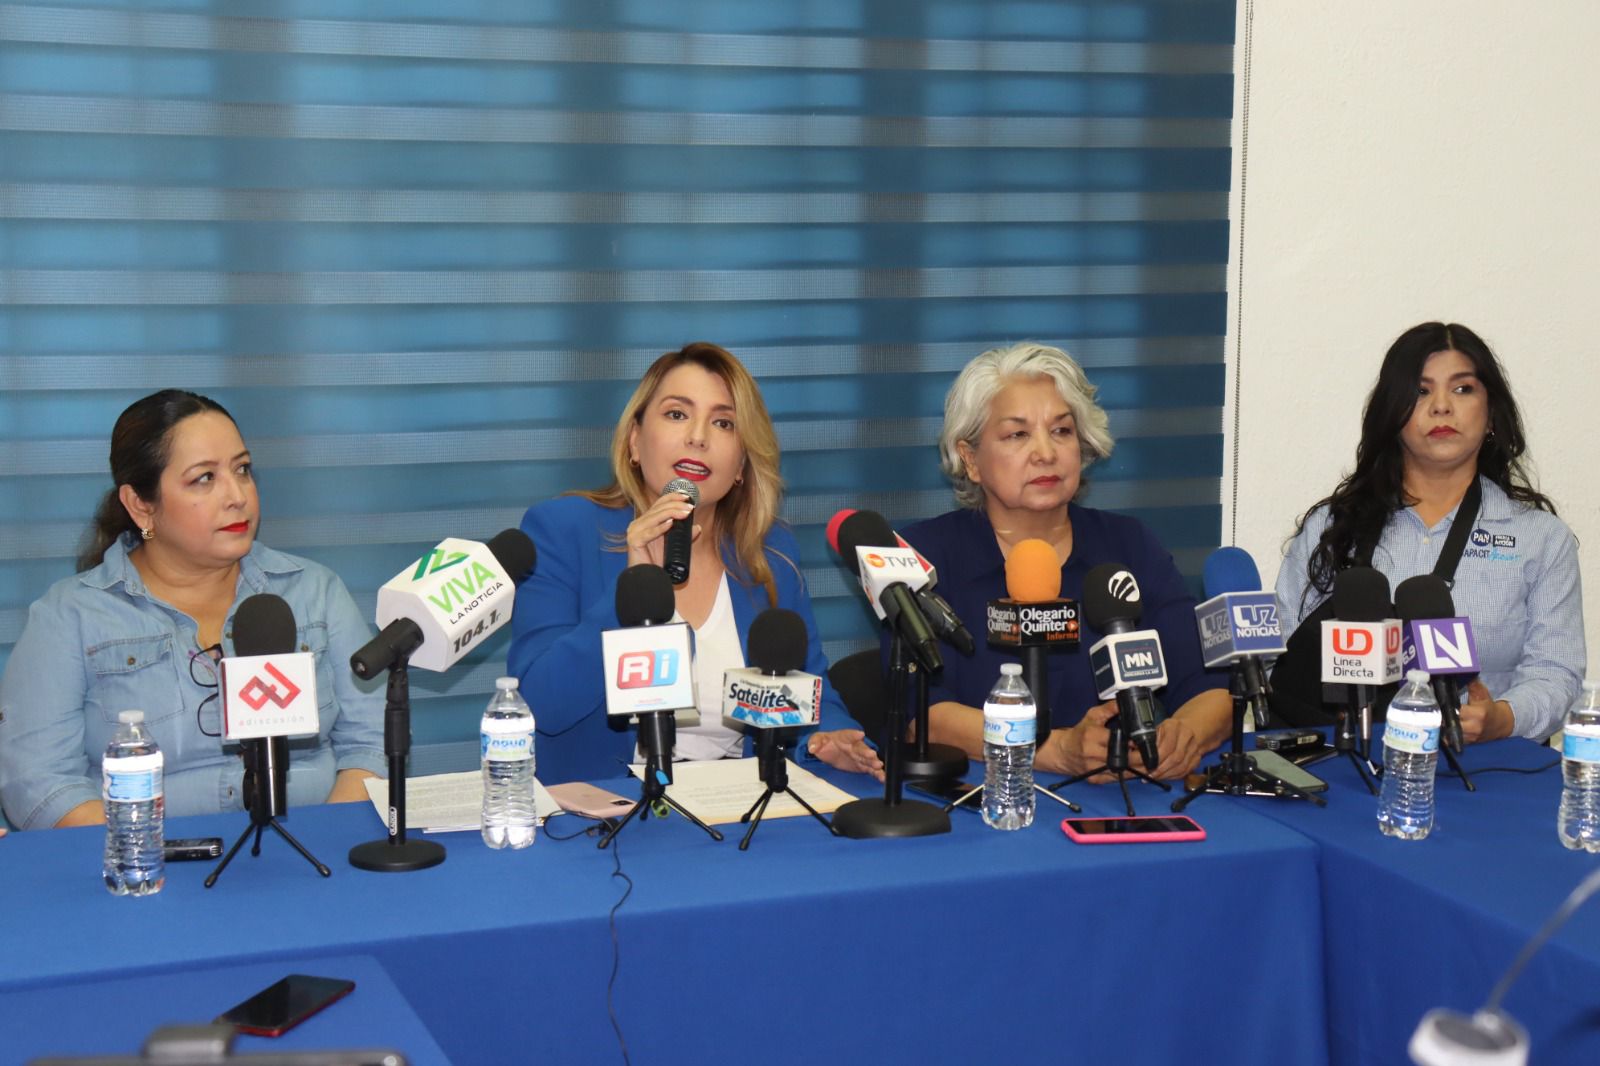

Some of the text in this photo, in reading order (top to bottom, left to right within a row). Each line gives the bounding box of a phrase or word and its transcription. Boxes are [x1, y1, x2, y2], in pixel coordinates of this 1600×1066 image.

[1473, 532, 1490, 544] PAN
[884, 556, 918, 568] TVP
[427, 560, 497, 614] VIVA
[450, 582, 503, 625] LA NOTICIA
[987, 606, 1016, 623] Olegario
[1020, 606, 1075, 622] Olegario
[1233, 604, 1279, 628] LUZ
[454, 609, 497, 653] 104.1
[1047, 631, 1078, 641] Informa
[1236, 626, 1281, 638] NOTICIAS
[1124, 651, 1154, 669] MN
[1333, 667, 1374, 678] Directa
